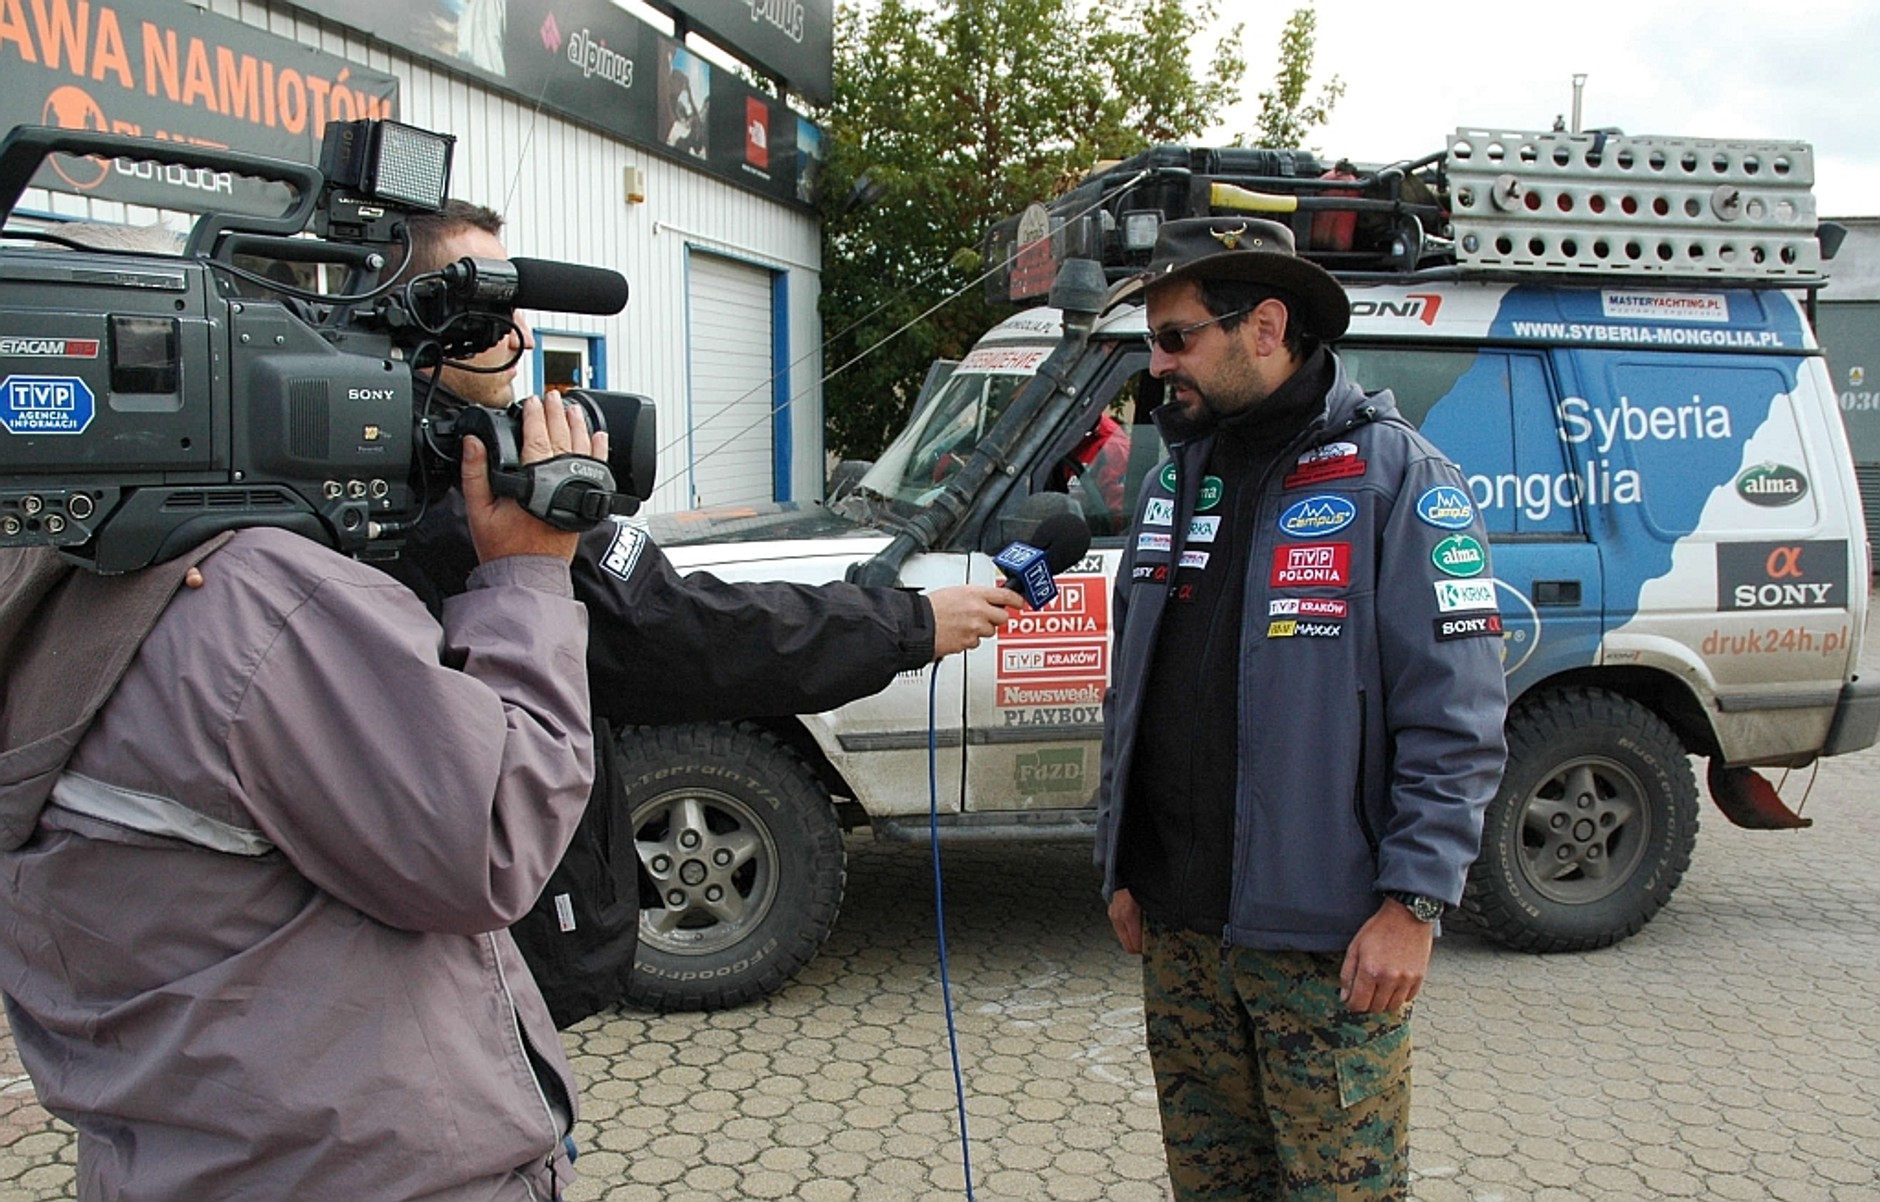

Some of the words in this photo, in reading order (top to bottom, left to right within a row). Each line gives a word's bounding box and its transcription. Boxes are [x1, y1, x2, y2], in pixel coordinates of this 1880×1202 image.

[567, 28, 634, 88] alpinus
[1513, 321, 1783, 347] WWW.SYBERIA-MONGOLIA.PL
[14, 386, 70, 407] TVP
[348, 388, 395, 401] SONY
[9, 419, 78, 430] INFORMACJI
[1556, 396, 1733, 453] Syberia
[1455, 458, 1643, 520] ongolia
[1744, 476, 1799, 498] alma
[1291, 550, 1331, 568] TVP
[1442, 548, 1481, 565] alma
[1029, 564, 1051, 597] TVP
[1279, 568, 1341, 582] POLONIA
[1733, 583, 1833, 608] SONY
[1300, 601, 1344, 615] KRAKÓW
[1008, 616, 1098, 634] POLONIA
[1442, 618, 1486, 635] SONY
[1702, 625, 1848, 658] druk24h.pl
[1008, 653, 1042, 666] TVP
[1046, 650, 1098, 665] KRAKÓW
[1004, 683, 1100, 704] Newsweek
[1004, 706, 1100, 727] PLAYBOY
